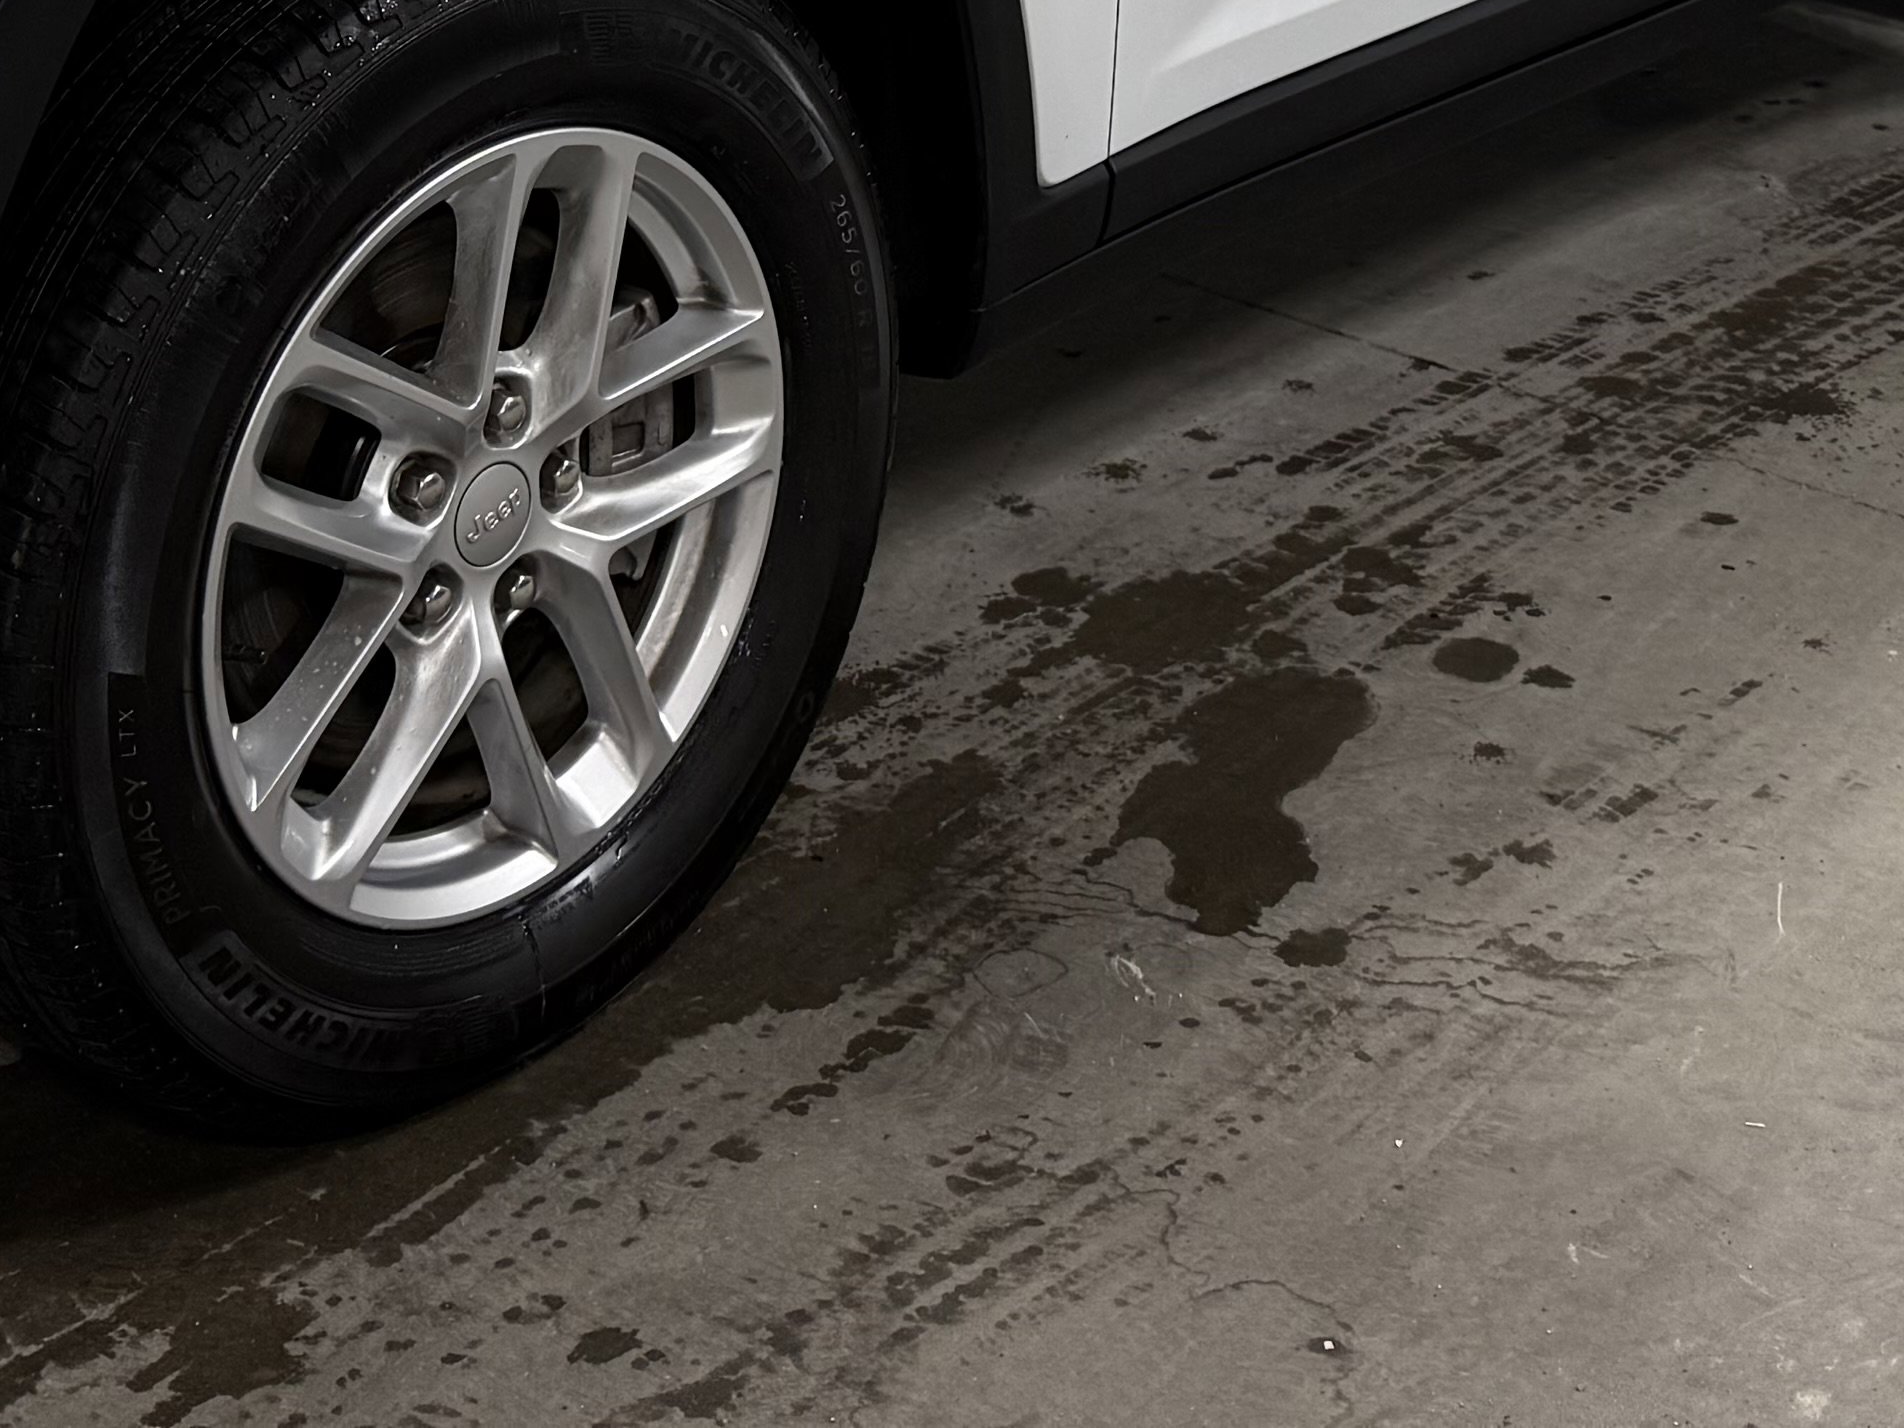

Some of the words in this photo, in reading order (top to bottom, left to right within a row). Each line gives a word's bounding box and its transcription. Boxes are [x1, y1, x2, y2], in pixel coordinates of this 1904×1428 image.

[463, 488, 520, 544] Jeep
[117, 708, 138, 760] LTX
[123, 776, 193, 927] PRIMACY
